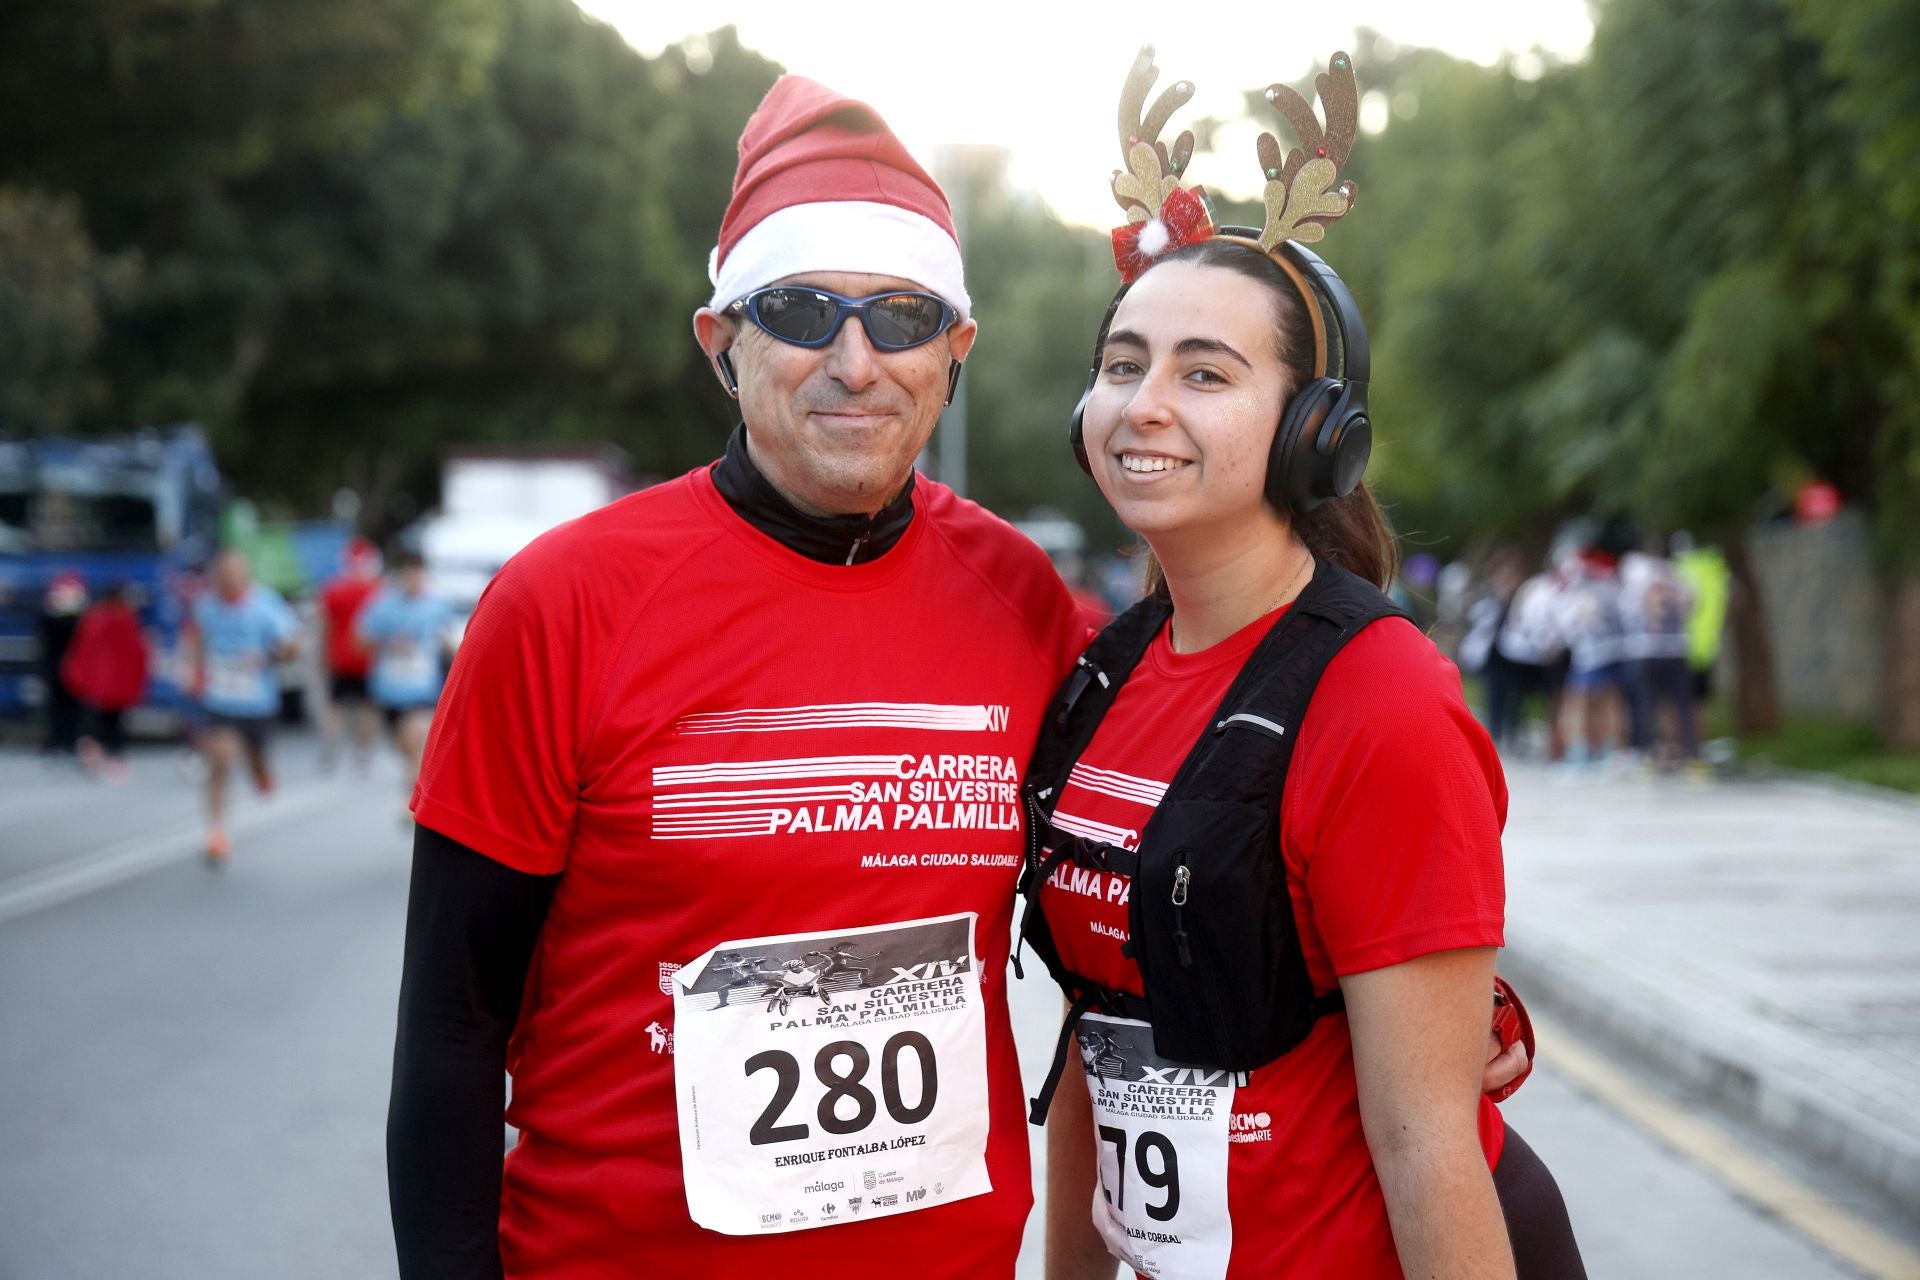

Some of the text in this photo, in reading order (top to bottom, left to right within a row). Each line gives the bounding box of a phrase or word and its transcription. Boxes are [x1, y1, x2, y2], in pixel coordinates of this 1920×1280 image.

[984, 705, 1010, 732] XIV
[896, 754, 1018, 780] CARRERA
[849, 780, 1018, 804] SAN SILVESTRE
[771, 803, 1020, 834] PALMA PALMILLA
[861, 853, 1018, 867] MÁLAGA CIUDAD SALUDABLE
[1047, 863, 1102, 900] ALMA
[1090, 921, 1126, 942] MÁLAGA
[885, 955, 968, 985] XIV
[870, 976, 964, 999] CARRERA
[770, 995, 967, 1031] PALMA PALMILLA
[817, 986, 964, 1016] SAN SILVESTRE
[830, 1004, 967, 1029] MÁLAGA CIUDAD SALUDABLE
[744, 1030, 938, 1146] 280
[1138, 1066, 1225, 1086] XIV
[1099, 1089, 1215, 1106] SAN SILVESTRE
[1128, 1084, 1217, 1098] CARRERA
[1092, 1097, 1214, 1116] LMA PALMILLA
[1130, 1111, 1158, 1119] CIUDAD
[1161, 1114, 1213, 1122] SALUDABLE
[775, 1135, 926, 1167] ENRIQUE FONTALBA LÓPEZ
[1098, 1123, 1180, 1222] 79
[1126, 1227, 1181, 1244] ALBA CORRAL
